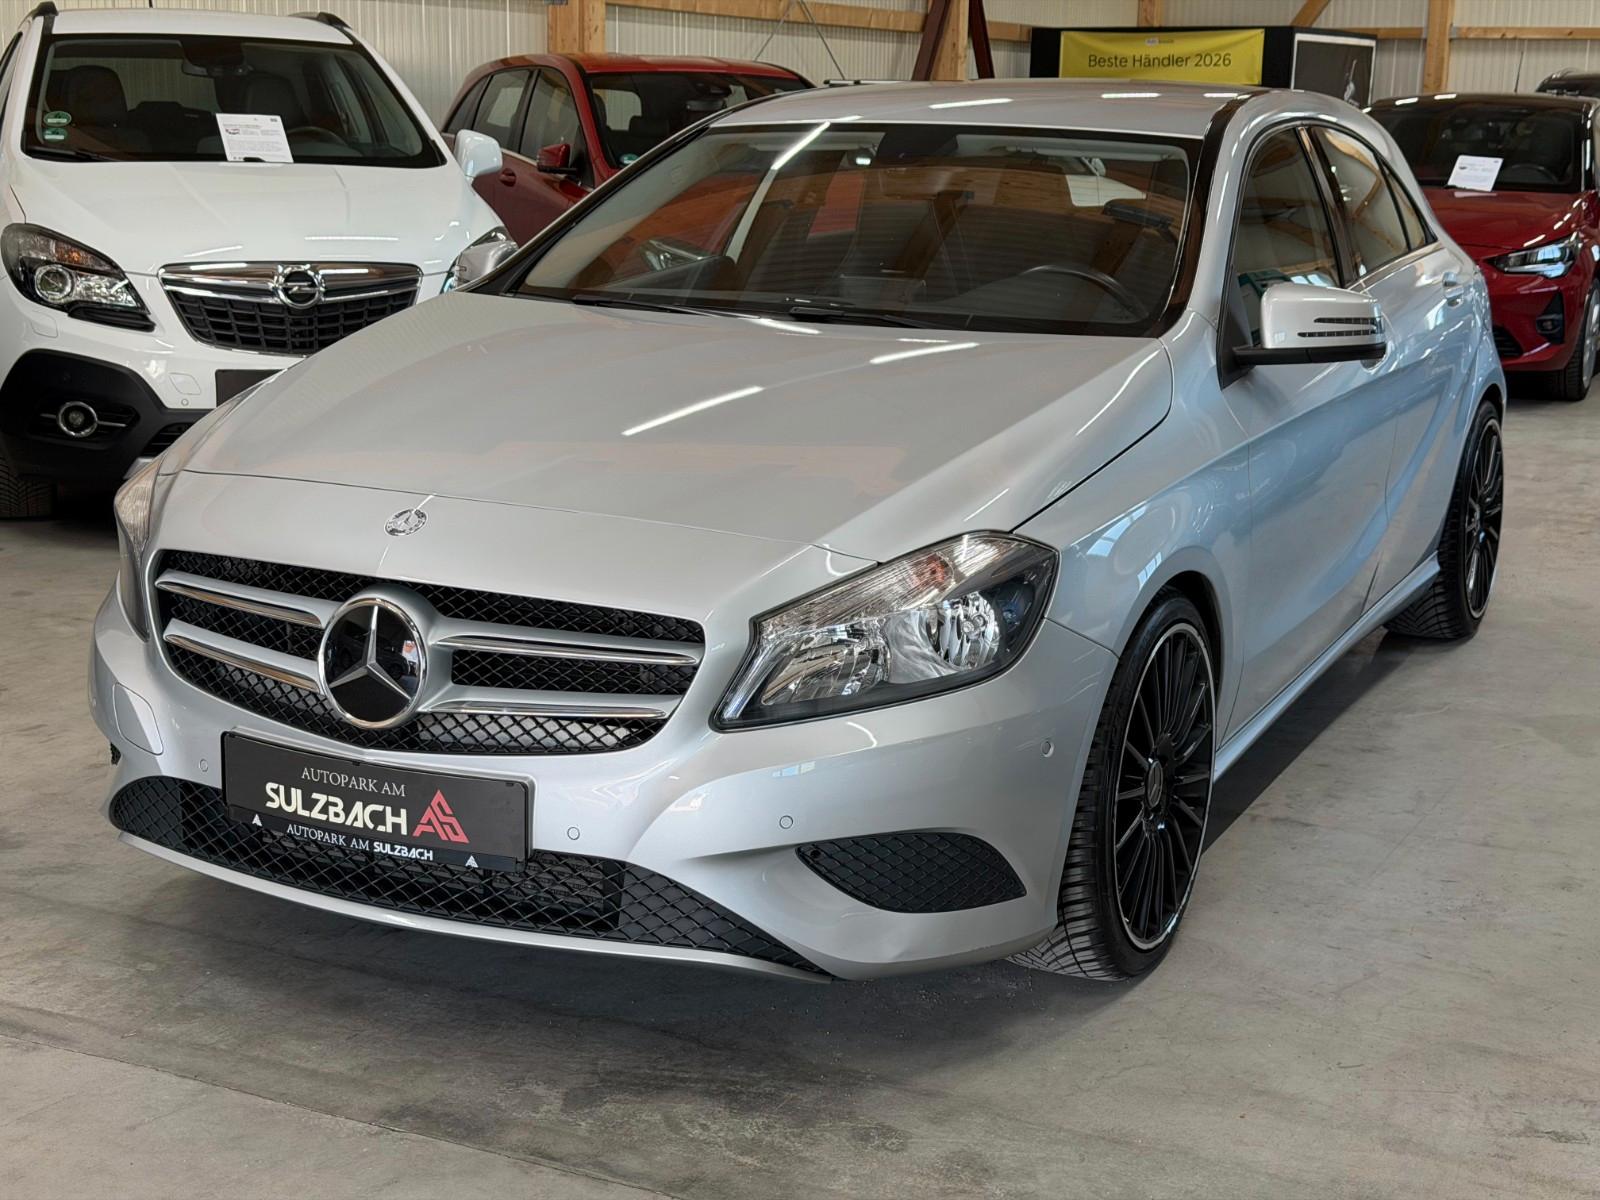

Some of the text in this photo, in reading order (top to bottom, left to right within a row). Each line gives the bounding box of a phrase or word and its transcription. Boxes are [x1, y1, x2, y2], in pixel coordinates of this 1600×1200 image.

[1088, 52, 1232, 68] Beste Händler 2026
[301, 767, 407, 798] AUTOPARK AM
[265, 781, 408, 836] SULZBACH
[286, 823, 433, 861] AUTOPARK AM SULZBACH
